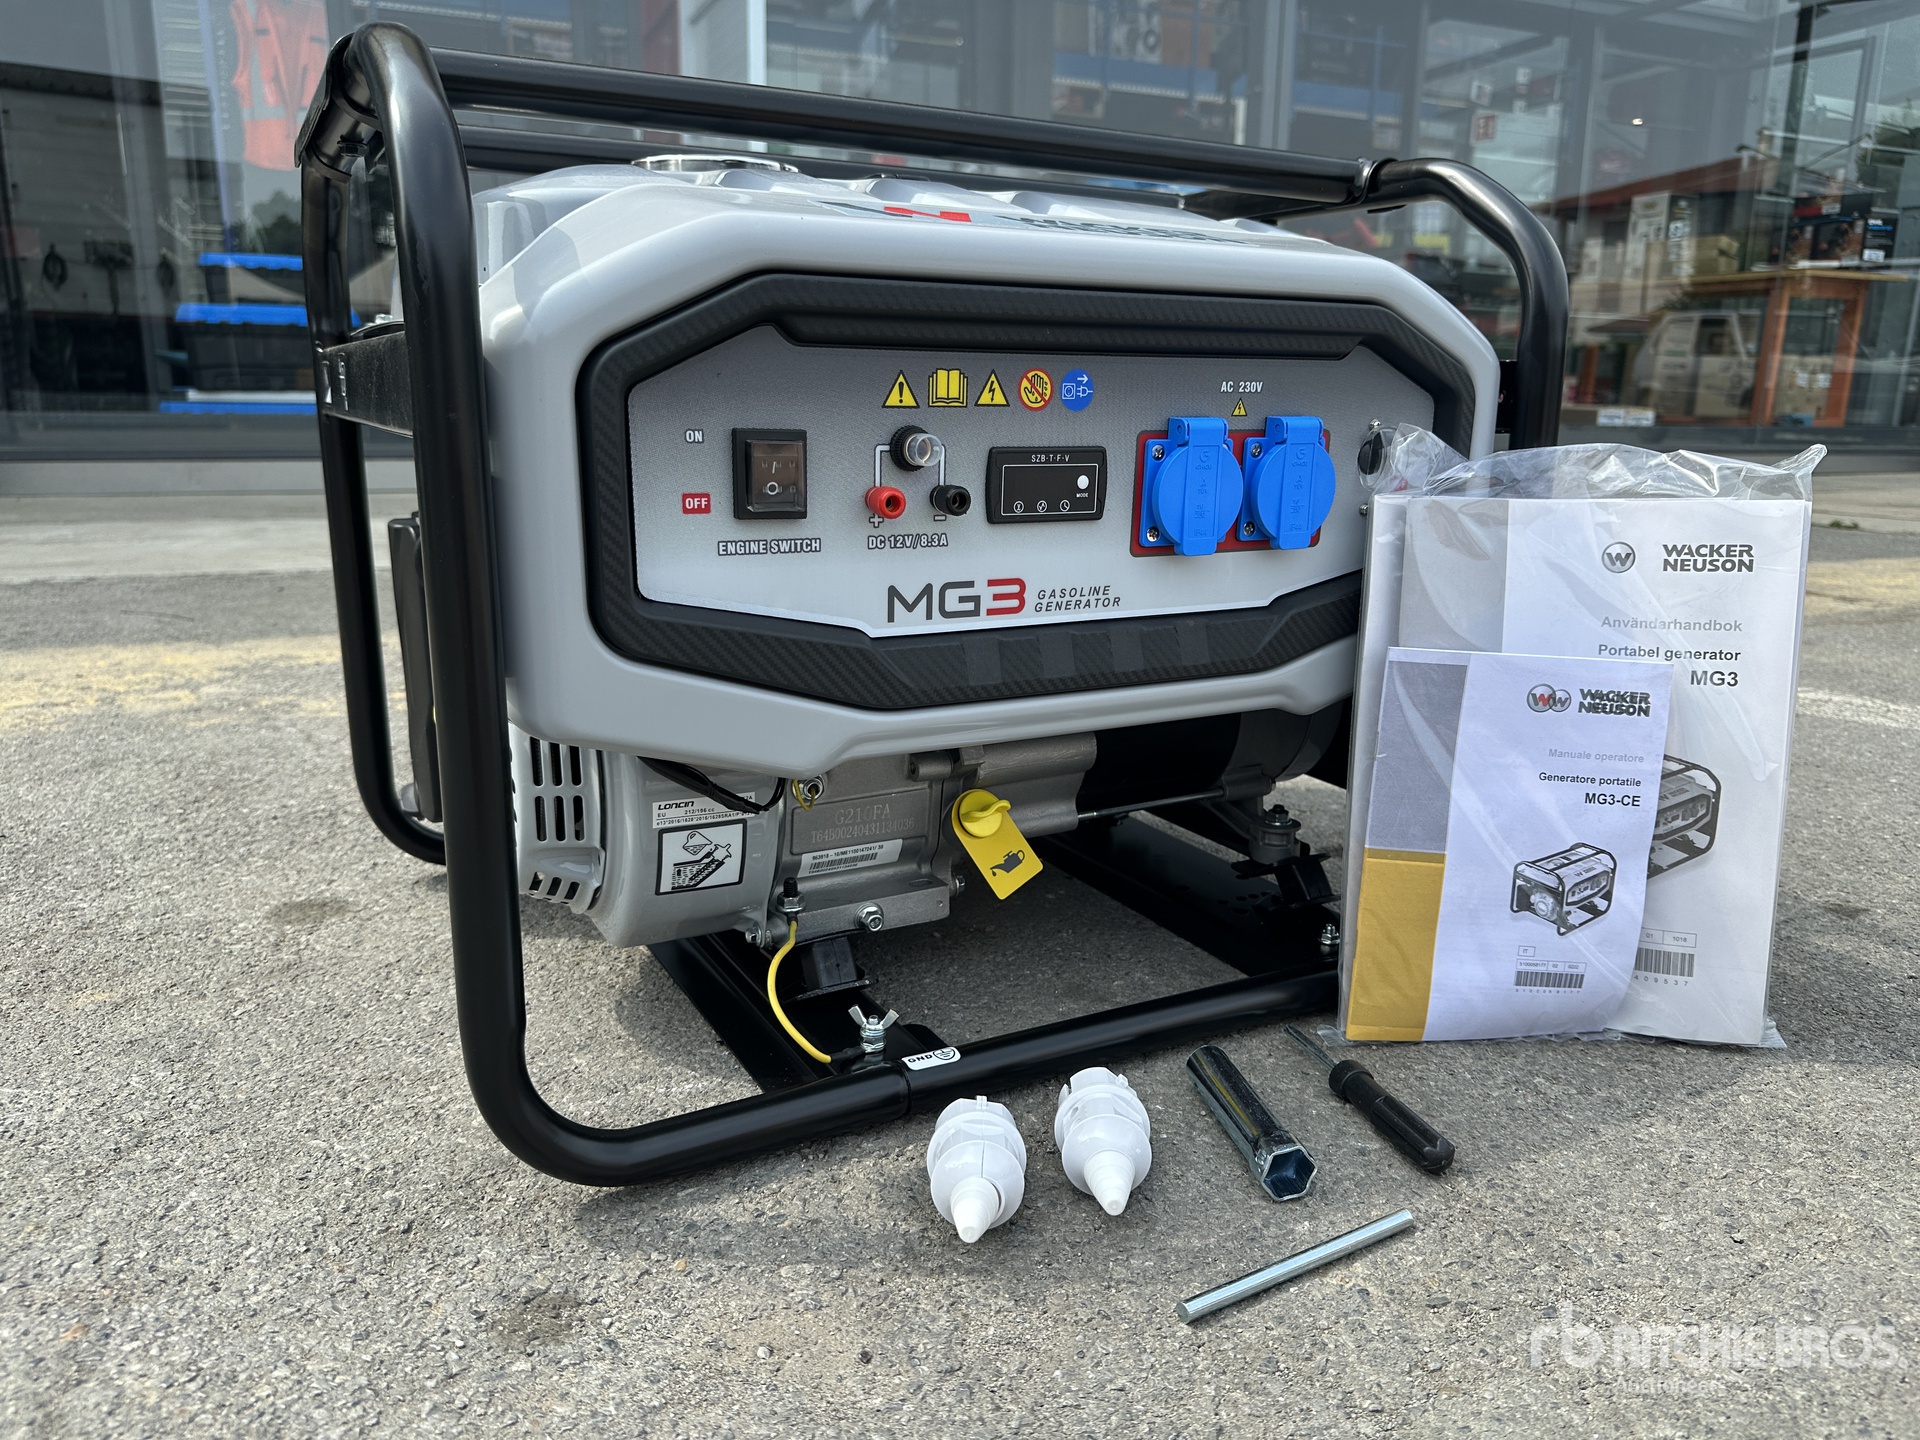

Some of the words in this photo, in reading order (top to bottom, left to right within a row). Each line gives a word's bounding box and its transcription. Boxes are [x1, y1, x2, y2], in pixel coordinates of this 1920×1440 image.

[1220, 381, 1234, 393] AC
[1238, 381, 1264, 393] 230V
[685, 430, 703, 442] ON
[685, 497, 708, 510] OFF
[719, 541, 768, 555] ENGINE
[770, 539, 820, 553] SWITCH
[868, 535, 885, 549] DC
[888, 533, 948, 549] 12V/8.3A
[1662, 544, 1754, 558] WACKER
[1662, 558, 1754, 573] NEUSON
[887, 577, 1027, 623] MG3
[1037, 585, 1111, 600] GASOLINE
[1034, 597, 1121, 613] GENERATOR
[1601, 616, 1743, 632] Användarhandbok
[1598, 644, 1660, 658] Portabel
[1664, 649, 1741, 661] generator
[1690, 670, 1739, 687] MG3
[1579, 688, 1651, 704] WACKER
[1578, 701, 1651, 717] NEUSON
[1548, 748, 1591, 760] Manuale
[1594, 752, 1644, 763] operatore
[1538, 772, 1596, 785] Generatore
[1598, 776, 1641, 787] portatile
[658, 801, 694, 811] LONCIN
[1584, 792, 1641, 807] MG3-CE
[907, 1054, 933, 1063] GND
